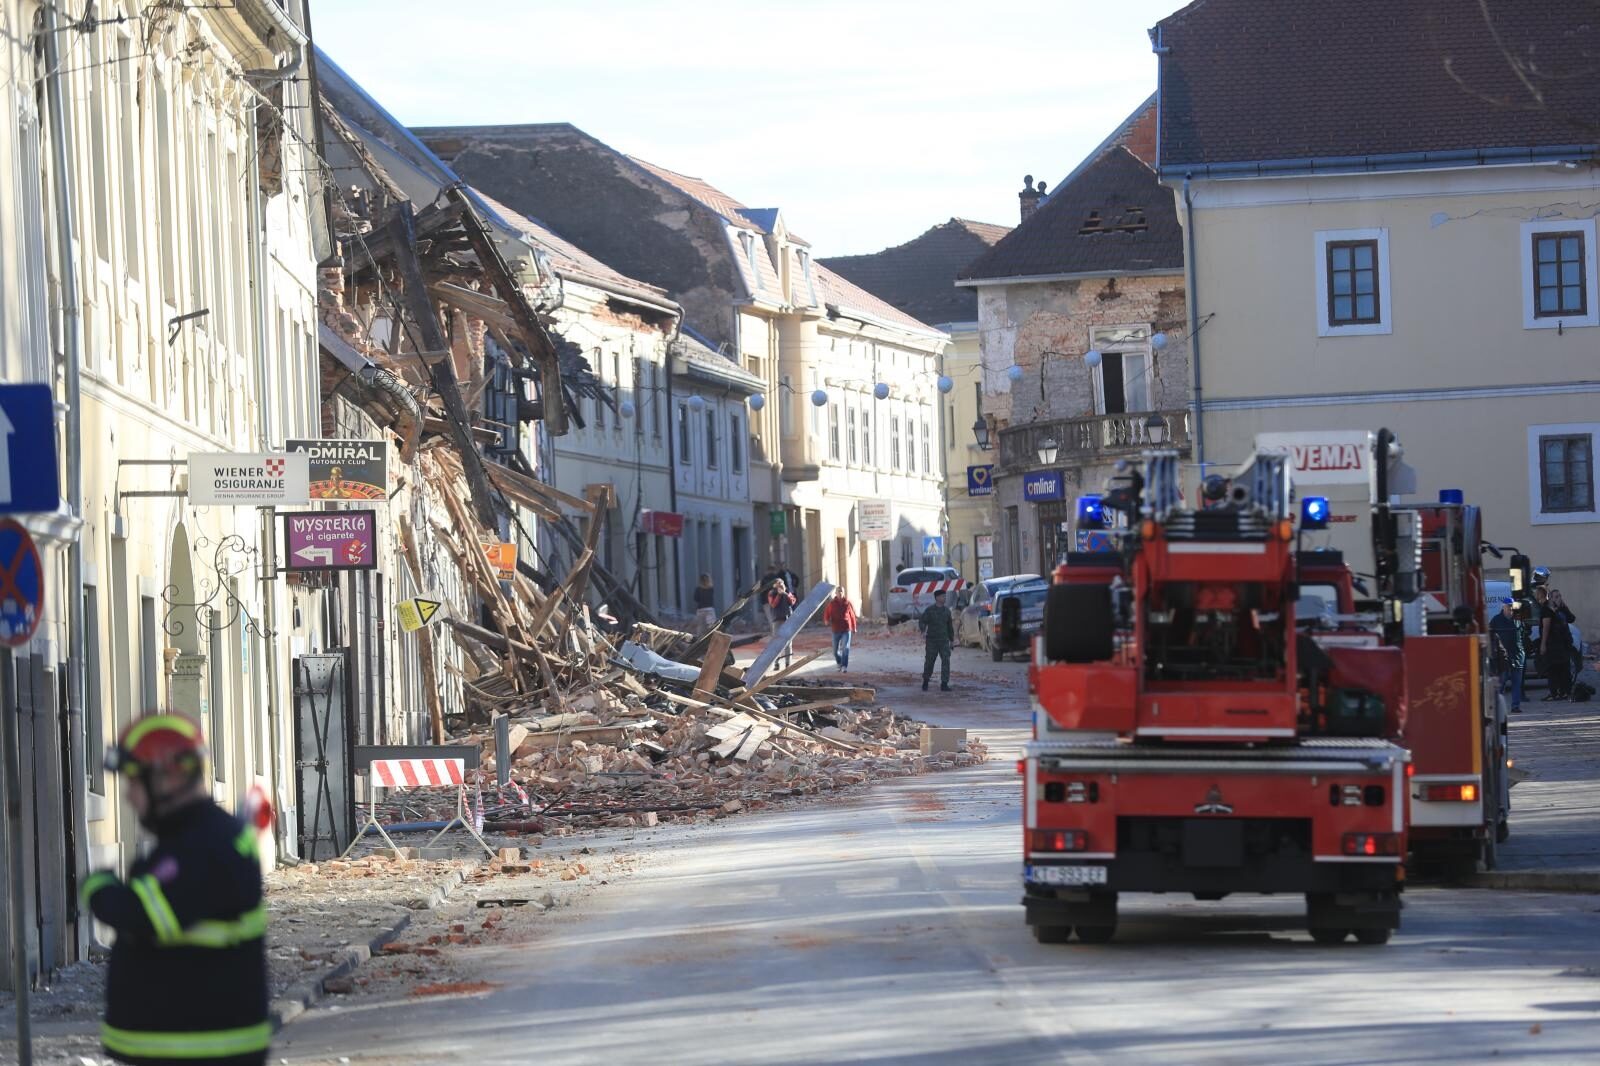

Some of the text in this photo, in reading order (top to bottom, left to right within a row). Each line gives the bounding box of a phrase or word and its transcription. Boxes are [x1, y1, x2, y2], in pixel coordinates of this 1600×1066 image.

[214, 467, 264, 477] WIENER
[214, 479, 285, 489] OSIGURANJE
[1033, 478, 1056, 495] mlinar
[293, 516, 366, 533] MYSTERIA
[317, 531, 355, 541] cigarete
